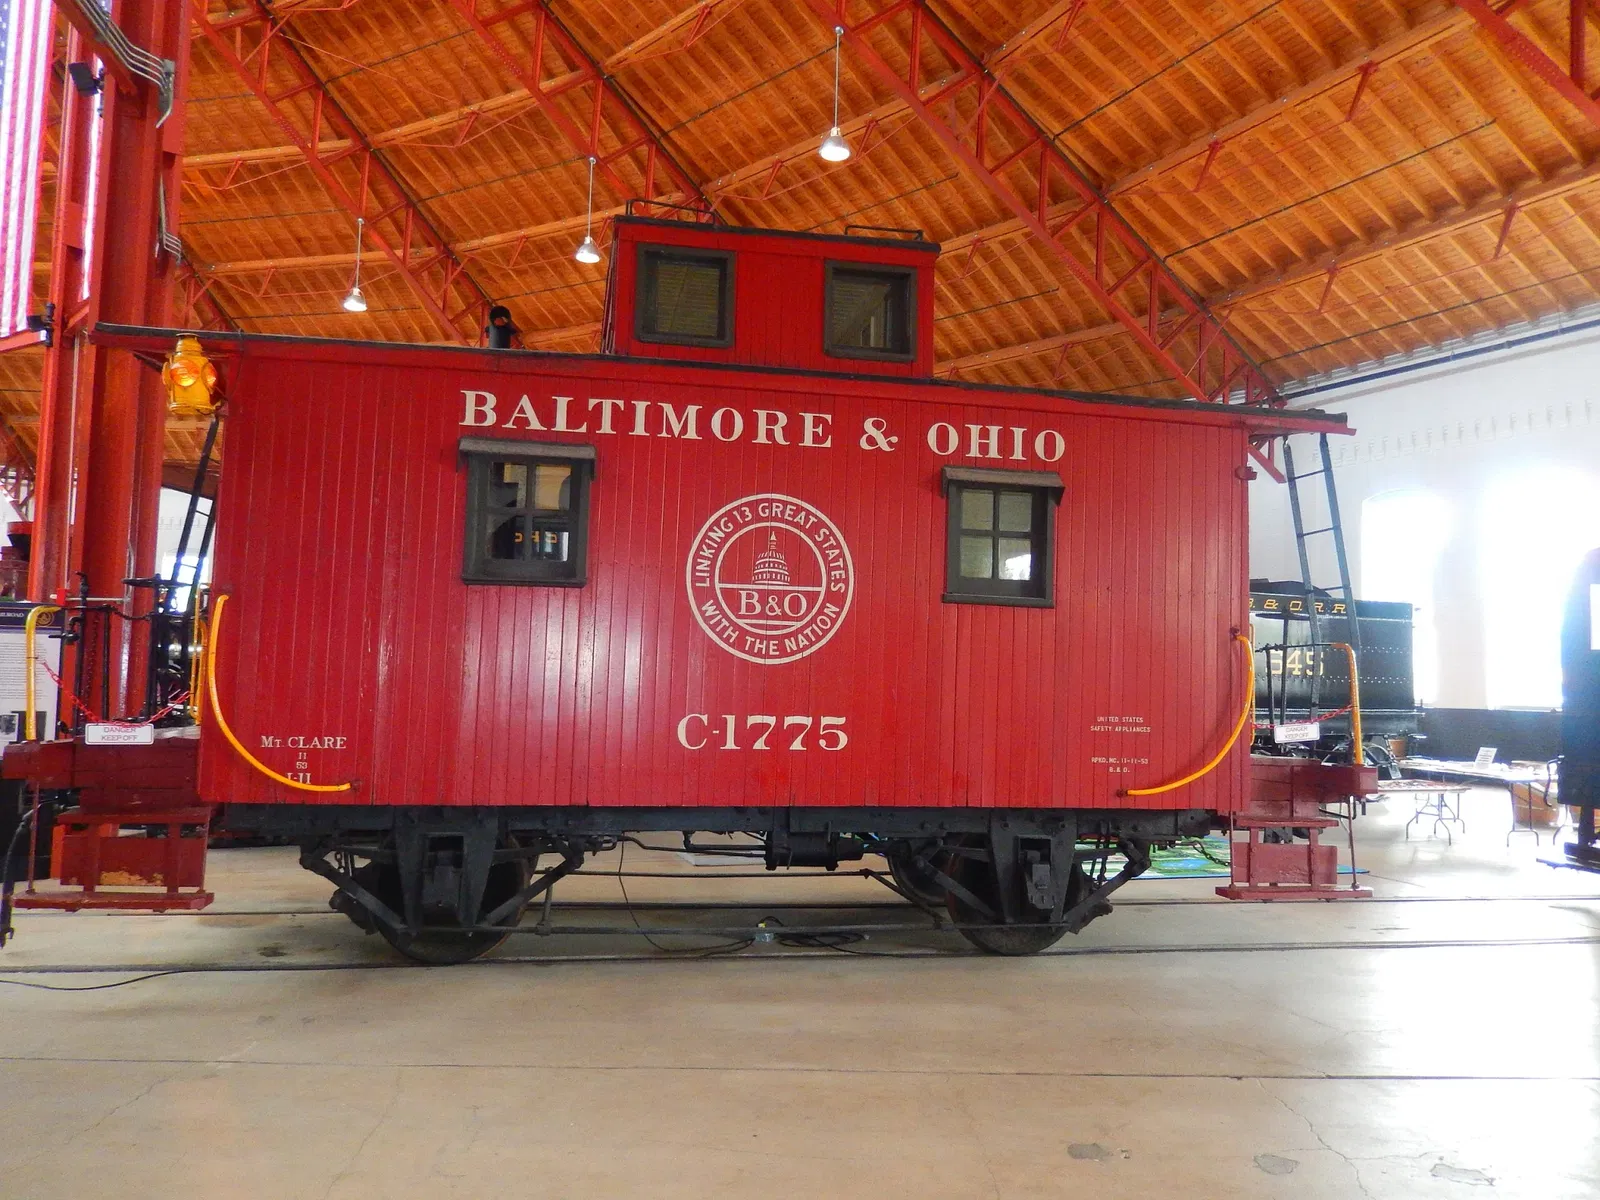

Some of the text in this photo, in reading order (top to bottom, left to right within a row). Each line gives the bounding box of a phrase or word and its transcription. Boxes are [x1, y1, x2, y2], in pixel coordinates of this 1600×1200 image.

[459, 390, 1066, 462] BALTIMORE & OHIO
[695, 502, 846, 593] LINKING 13 GREAT STATES
[738, 590, 807, 617] B&O
[701, 599, 840, 656] WITH THE NATION
[287, 736, 347, 749] CLARE
[677, 713, 848, 751] C-1775
